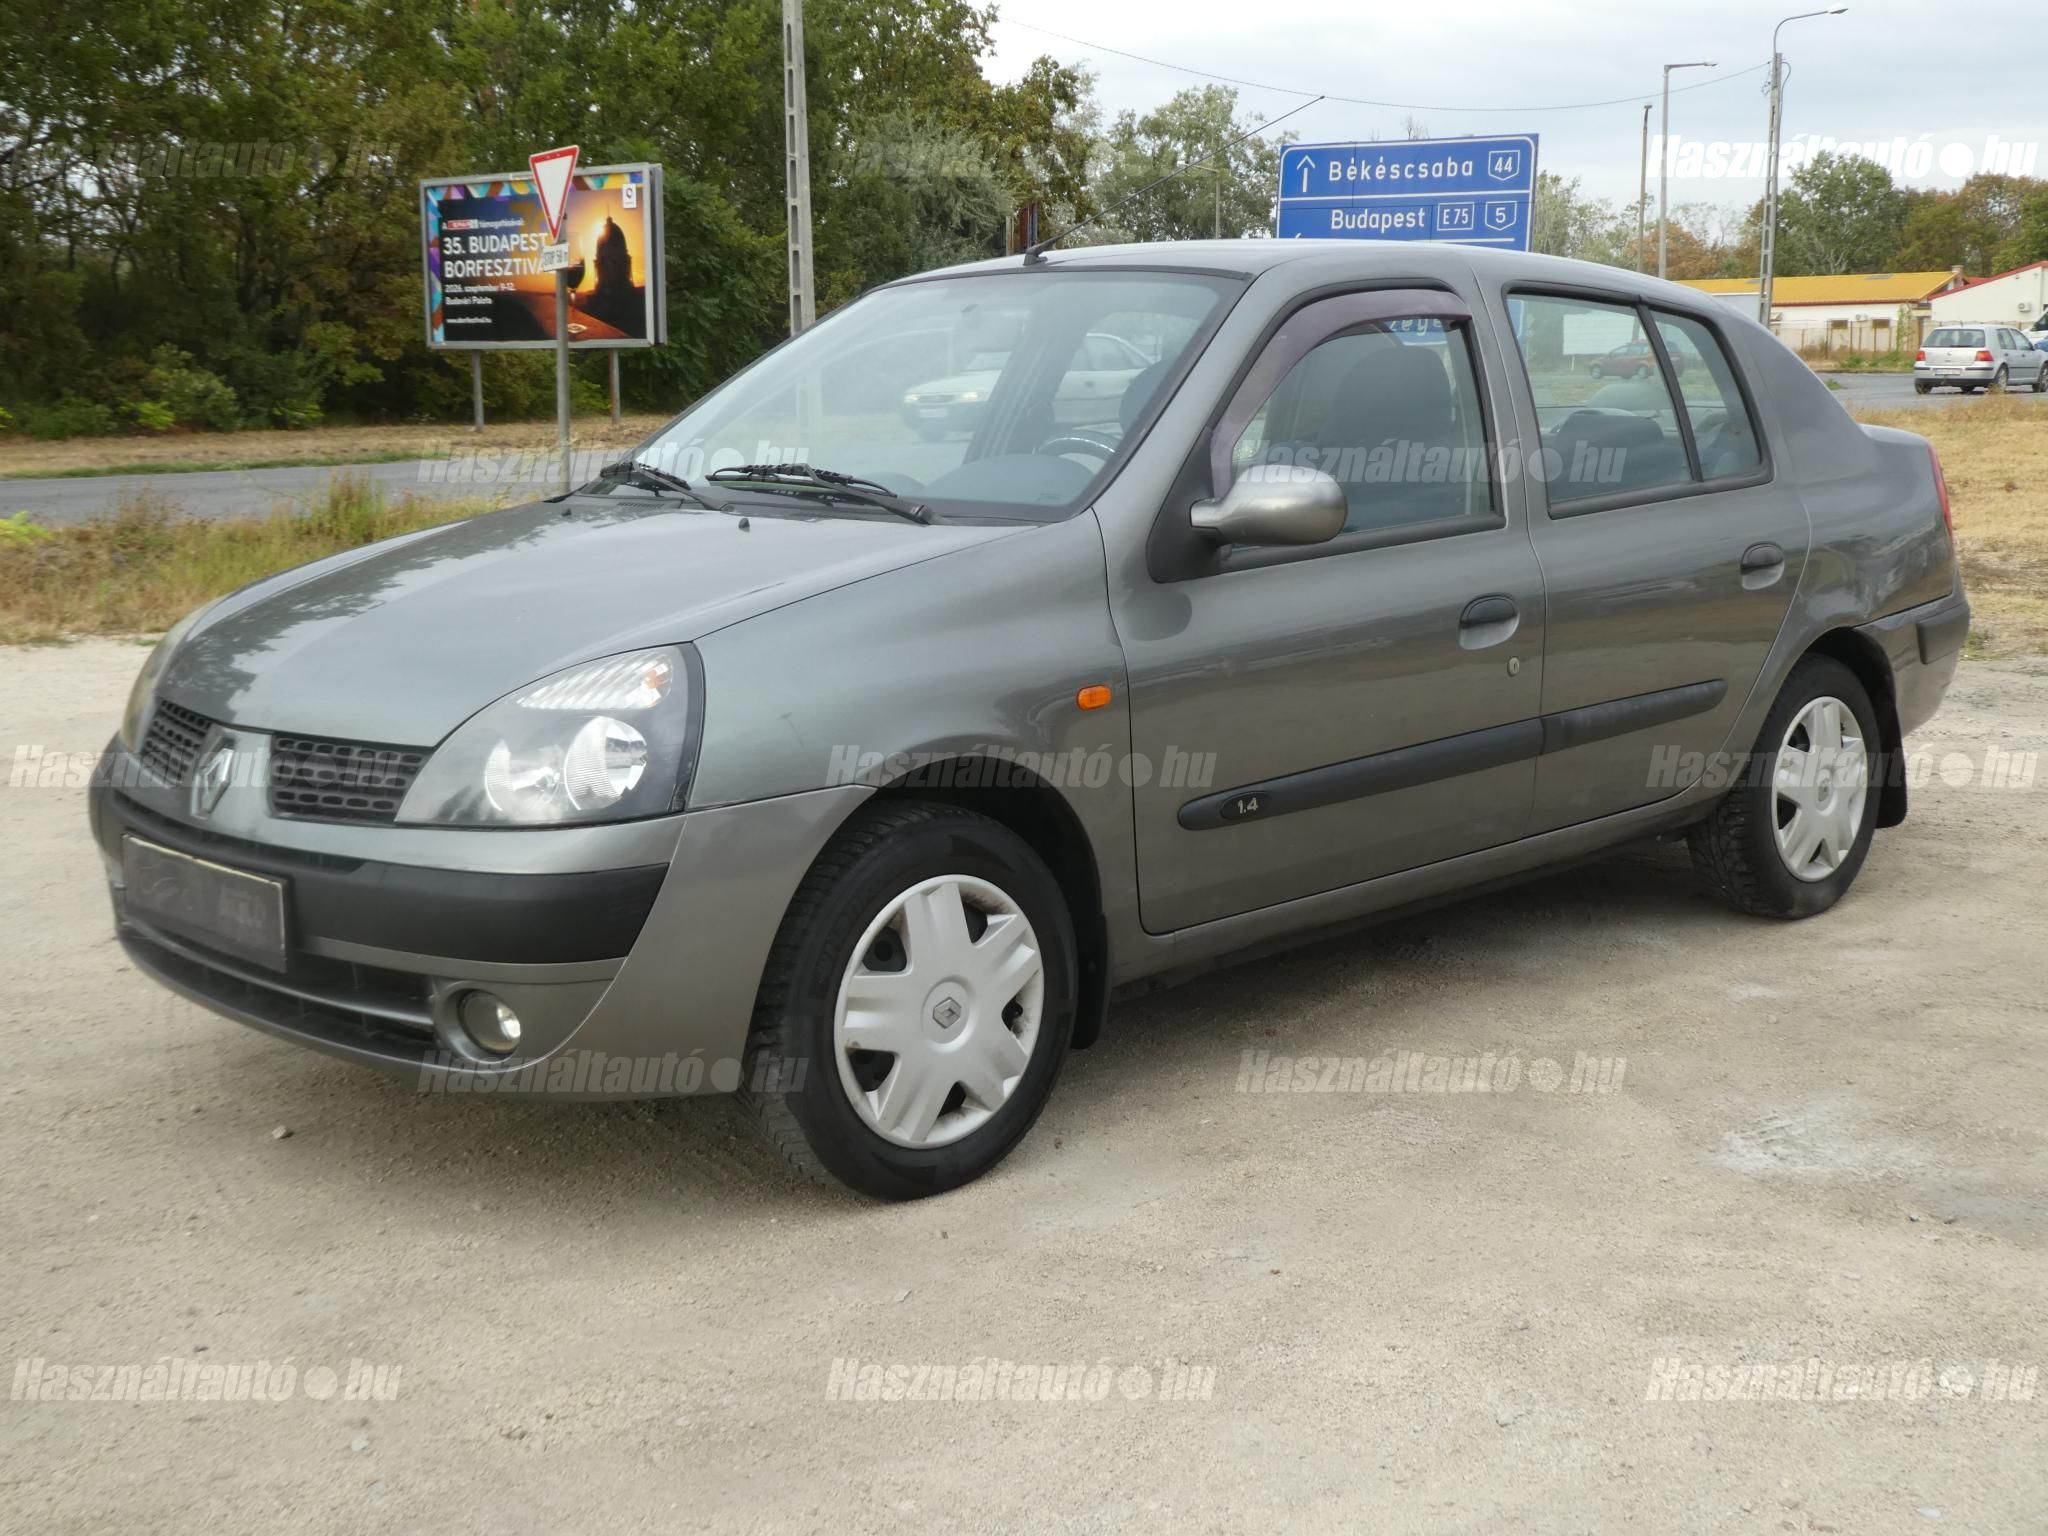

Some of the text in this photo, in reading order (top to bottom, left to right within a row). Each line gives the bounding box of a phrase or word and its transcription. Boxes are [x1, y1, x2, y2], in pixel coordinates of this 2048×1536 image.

[1328, 156, 1513, 182] Békéscsaba 44
[1331, 208, 1426, 233] Budapest
[1495, 207, 1506, 223] 5
[443, 233, 548, 255] 35. BUDAPEST
[444, 257, 556, 278] BORFESZTIV
[1238, 797, 1258, 814] 1.4
